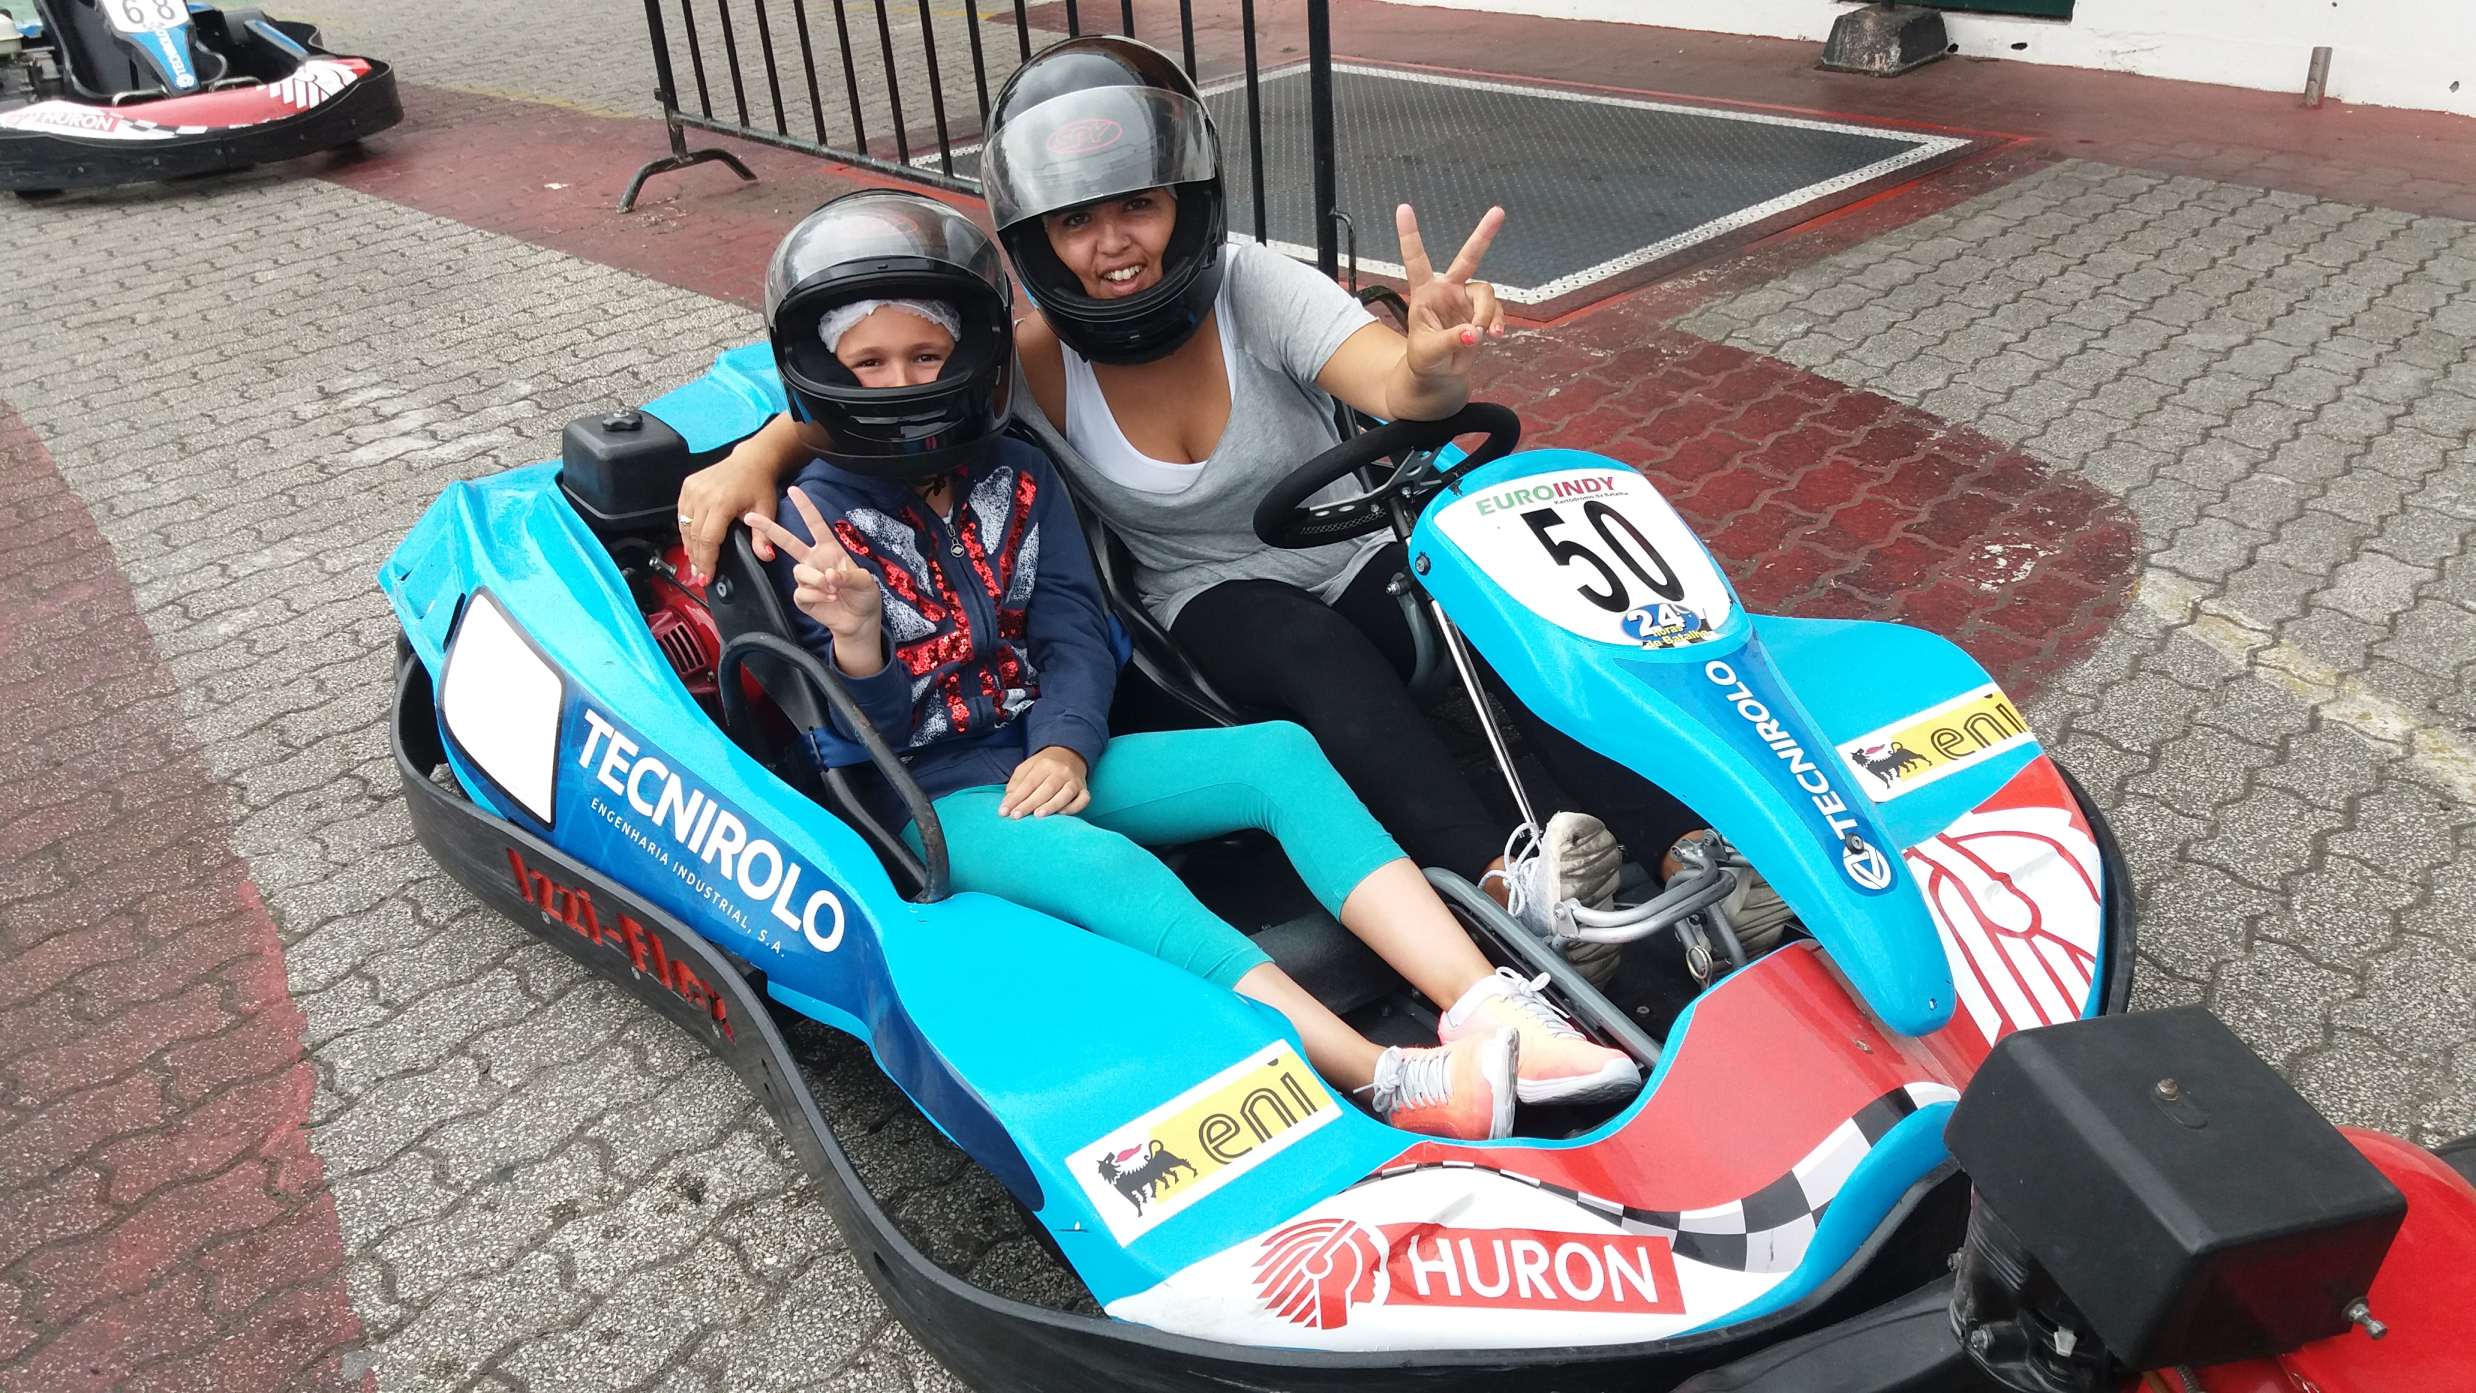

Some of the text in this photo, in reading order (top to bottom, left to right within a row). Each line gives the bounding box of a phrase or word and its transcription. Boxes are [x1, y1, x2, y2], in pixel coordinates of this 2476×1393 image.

[40, 111, 117, 131] HURON
[1475, 477, 1614, 516] EUROINDY
[1520, 501, 1685, 613] 50
[1627, 603, 1686, 638] 24
[1706, 660, 1860, 840] TECNIROLO
[1930, 692, 2028, 761] eni
[578, 708, 846, 953] TECNIROLO
[591, 797, 786, 959] ENGENHARIA INDUSTRIAL, S.A.
[1198, 1057, 1319, 1166] eni
[1407, 1234, 1659, 1303] HURON
